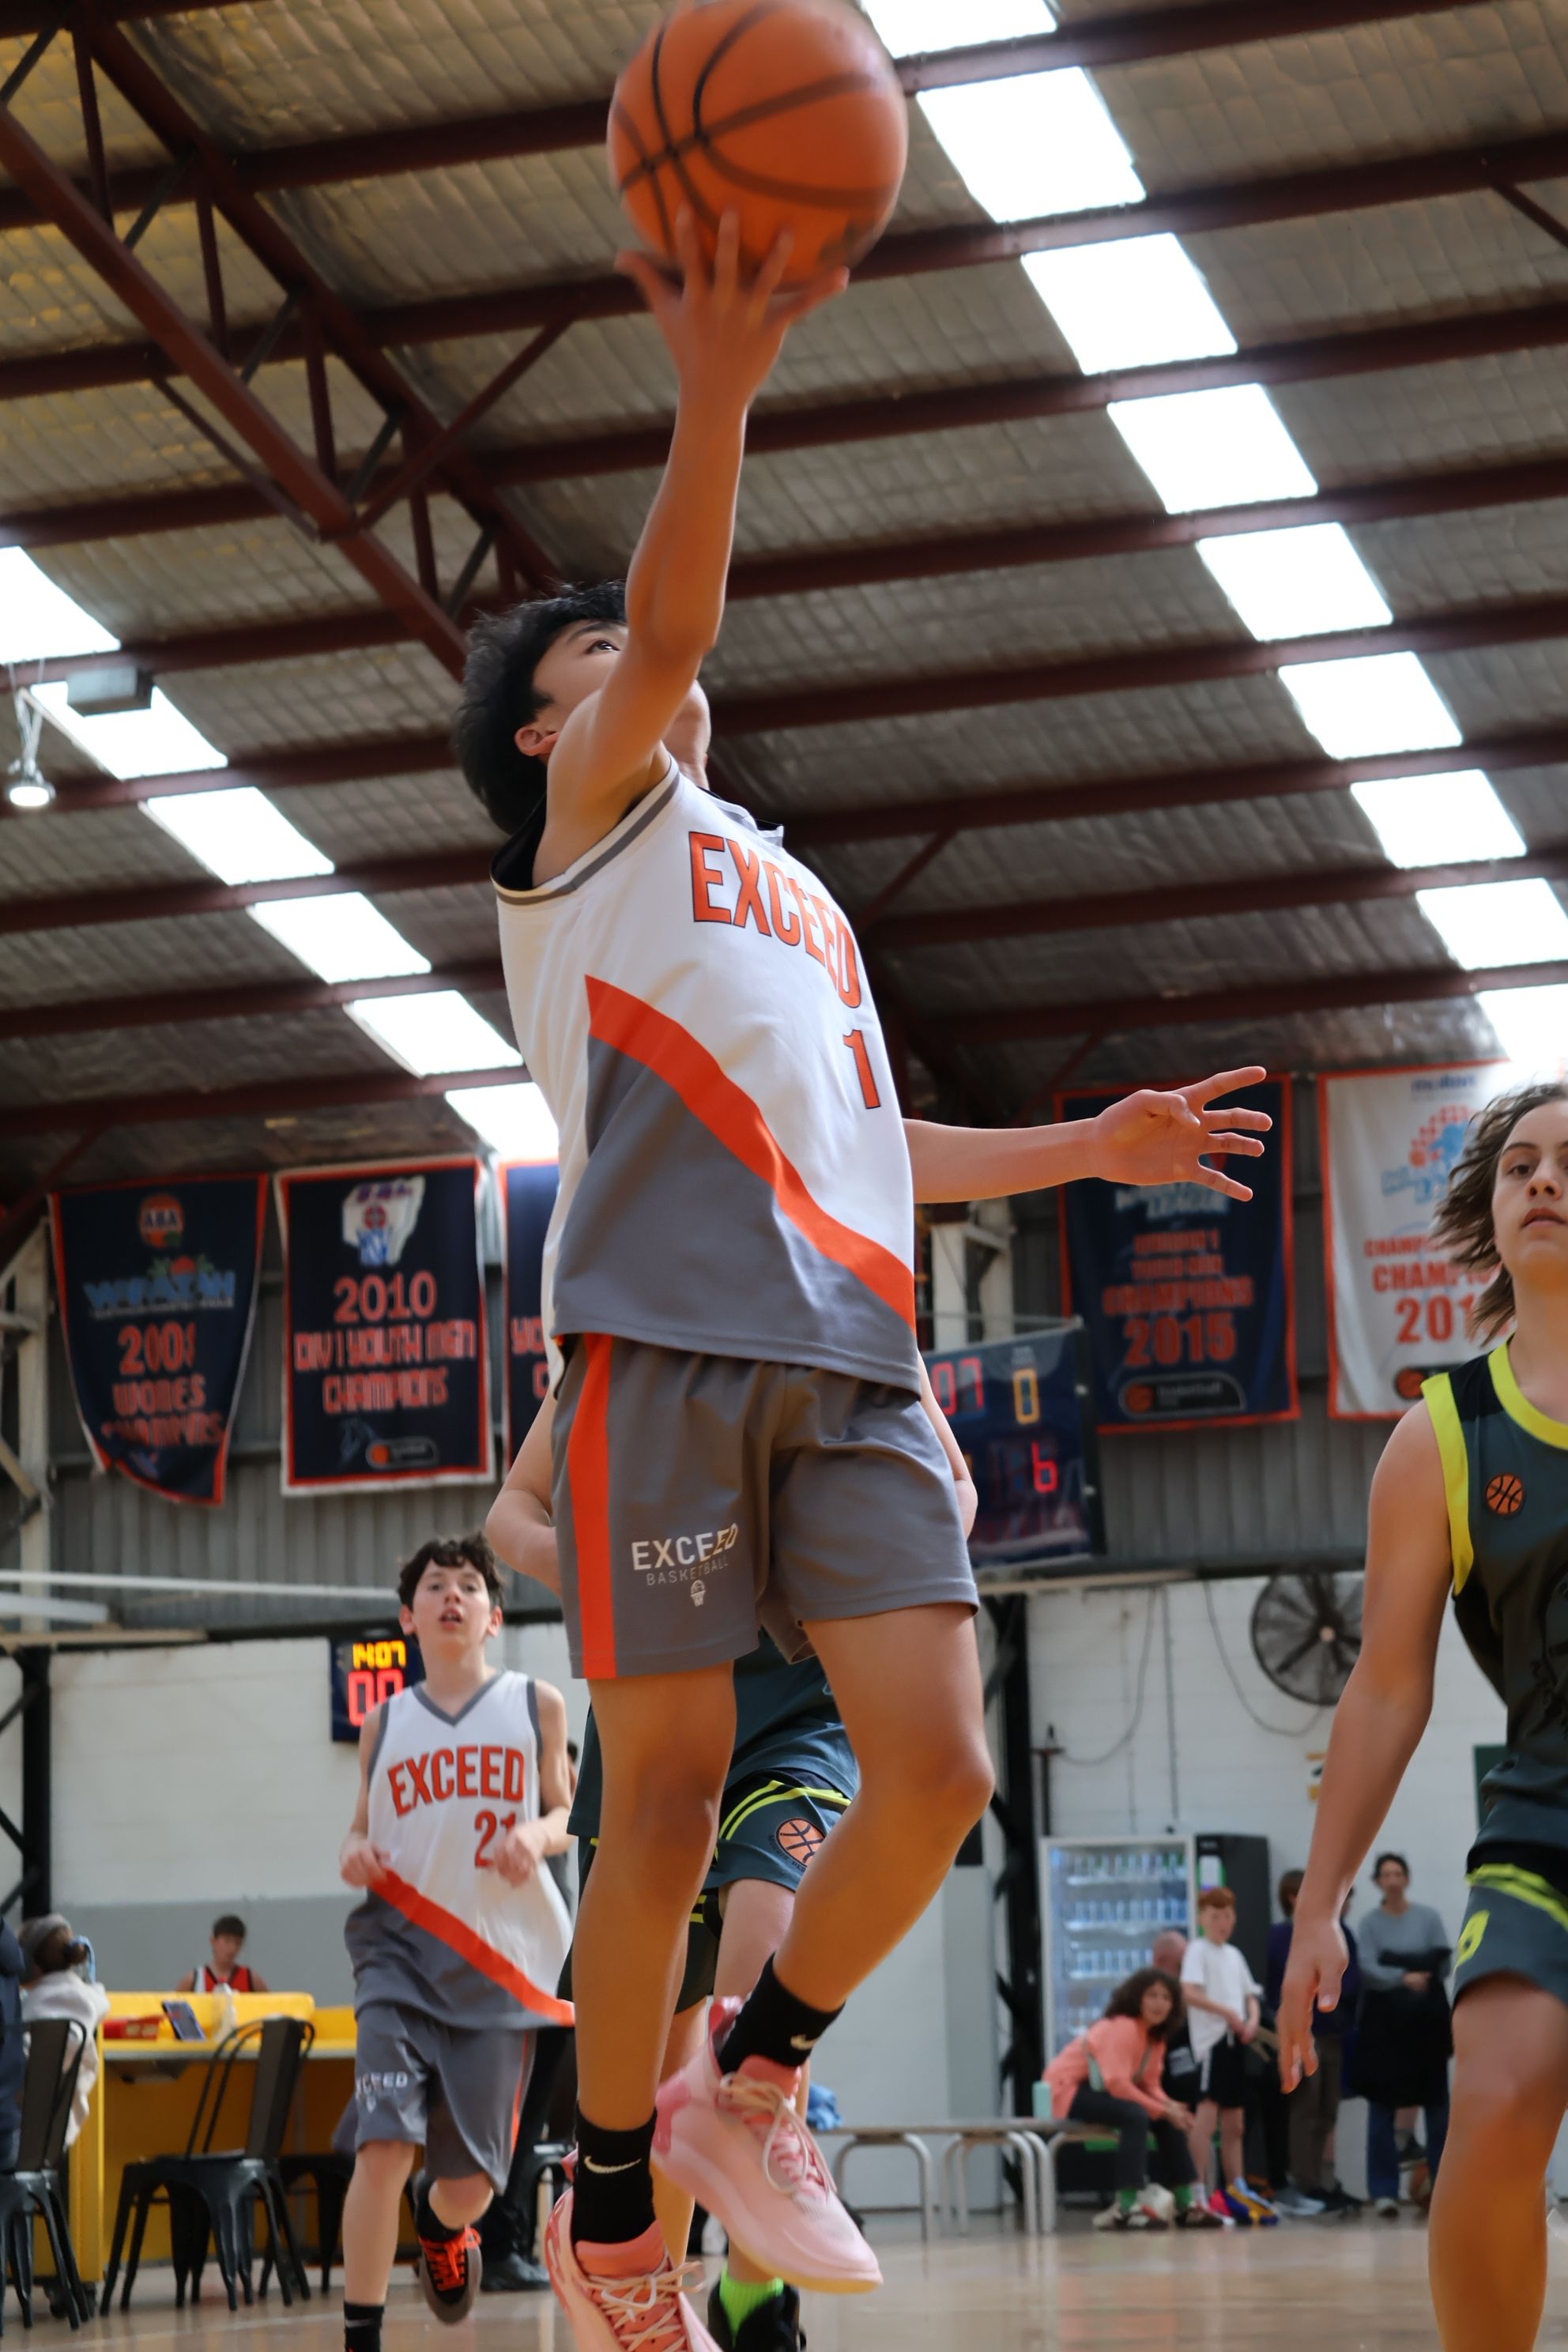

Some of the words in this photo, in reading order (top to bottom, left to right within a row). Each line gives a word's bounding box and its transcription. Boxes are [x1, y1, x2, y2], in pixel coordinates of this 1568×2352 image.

[688, 831, 861, 1008] EXCEED
[842, 1029, 880, 1109] 1
[334, 1271, 436, 1323] 2010
[1395, 1295, 1494, 1344] 201
[294, 1332, 332, 1370] DIV
[348, 1324, 422, 1366] YOUTH
[425, 1318, 476, 1360] MEN
[1122, 1312, 1237, 1367] 2015
[322, 1366, 448, 1414] CHAMPIONS
[1013, 1368, 1040, 1424] 0
[631, 1523, 739, 1570] EXCEED
[646, 1556, 729, 1586] BASKETBALL
[387, 1744, 525, 1818] EXCEED
